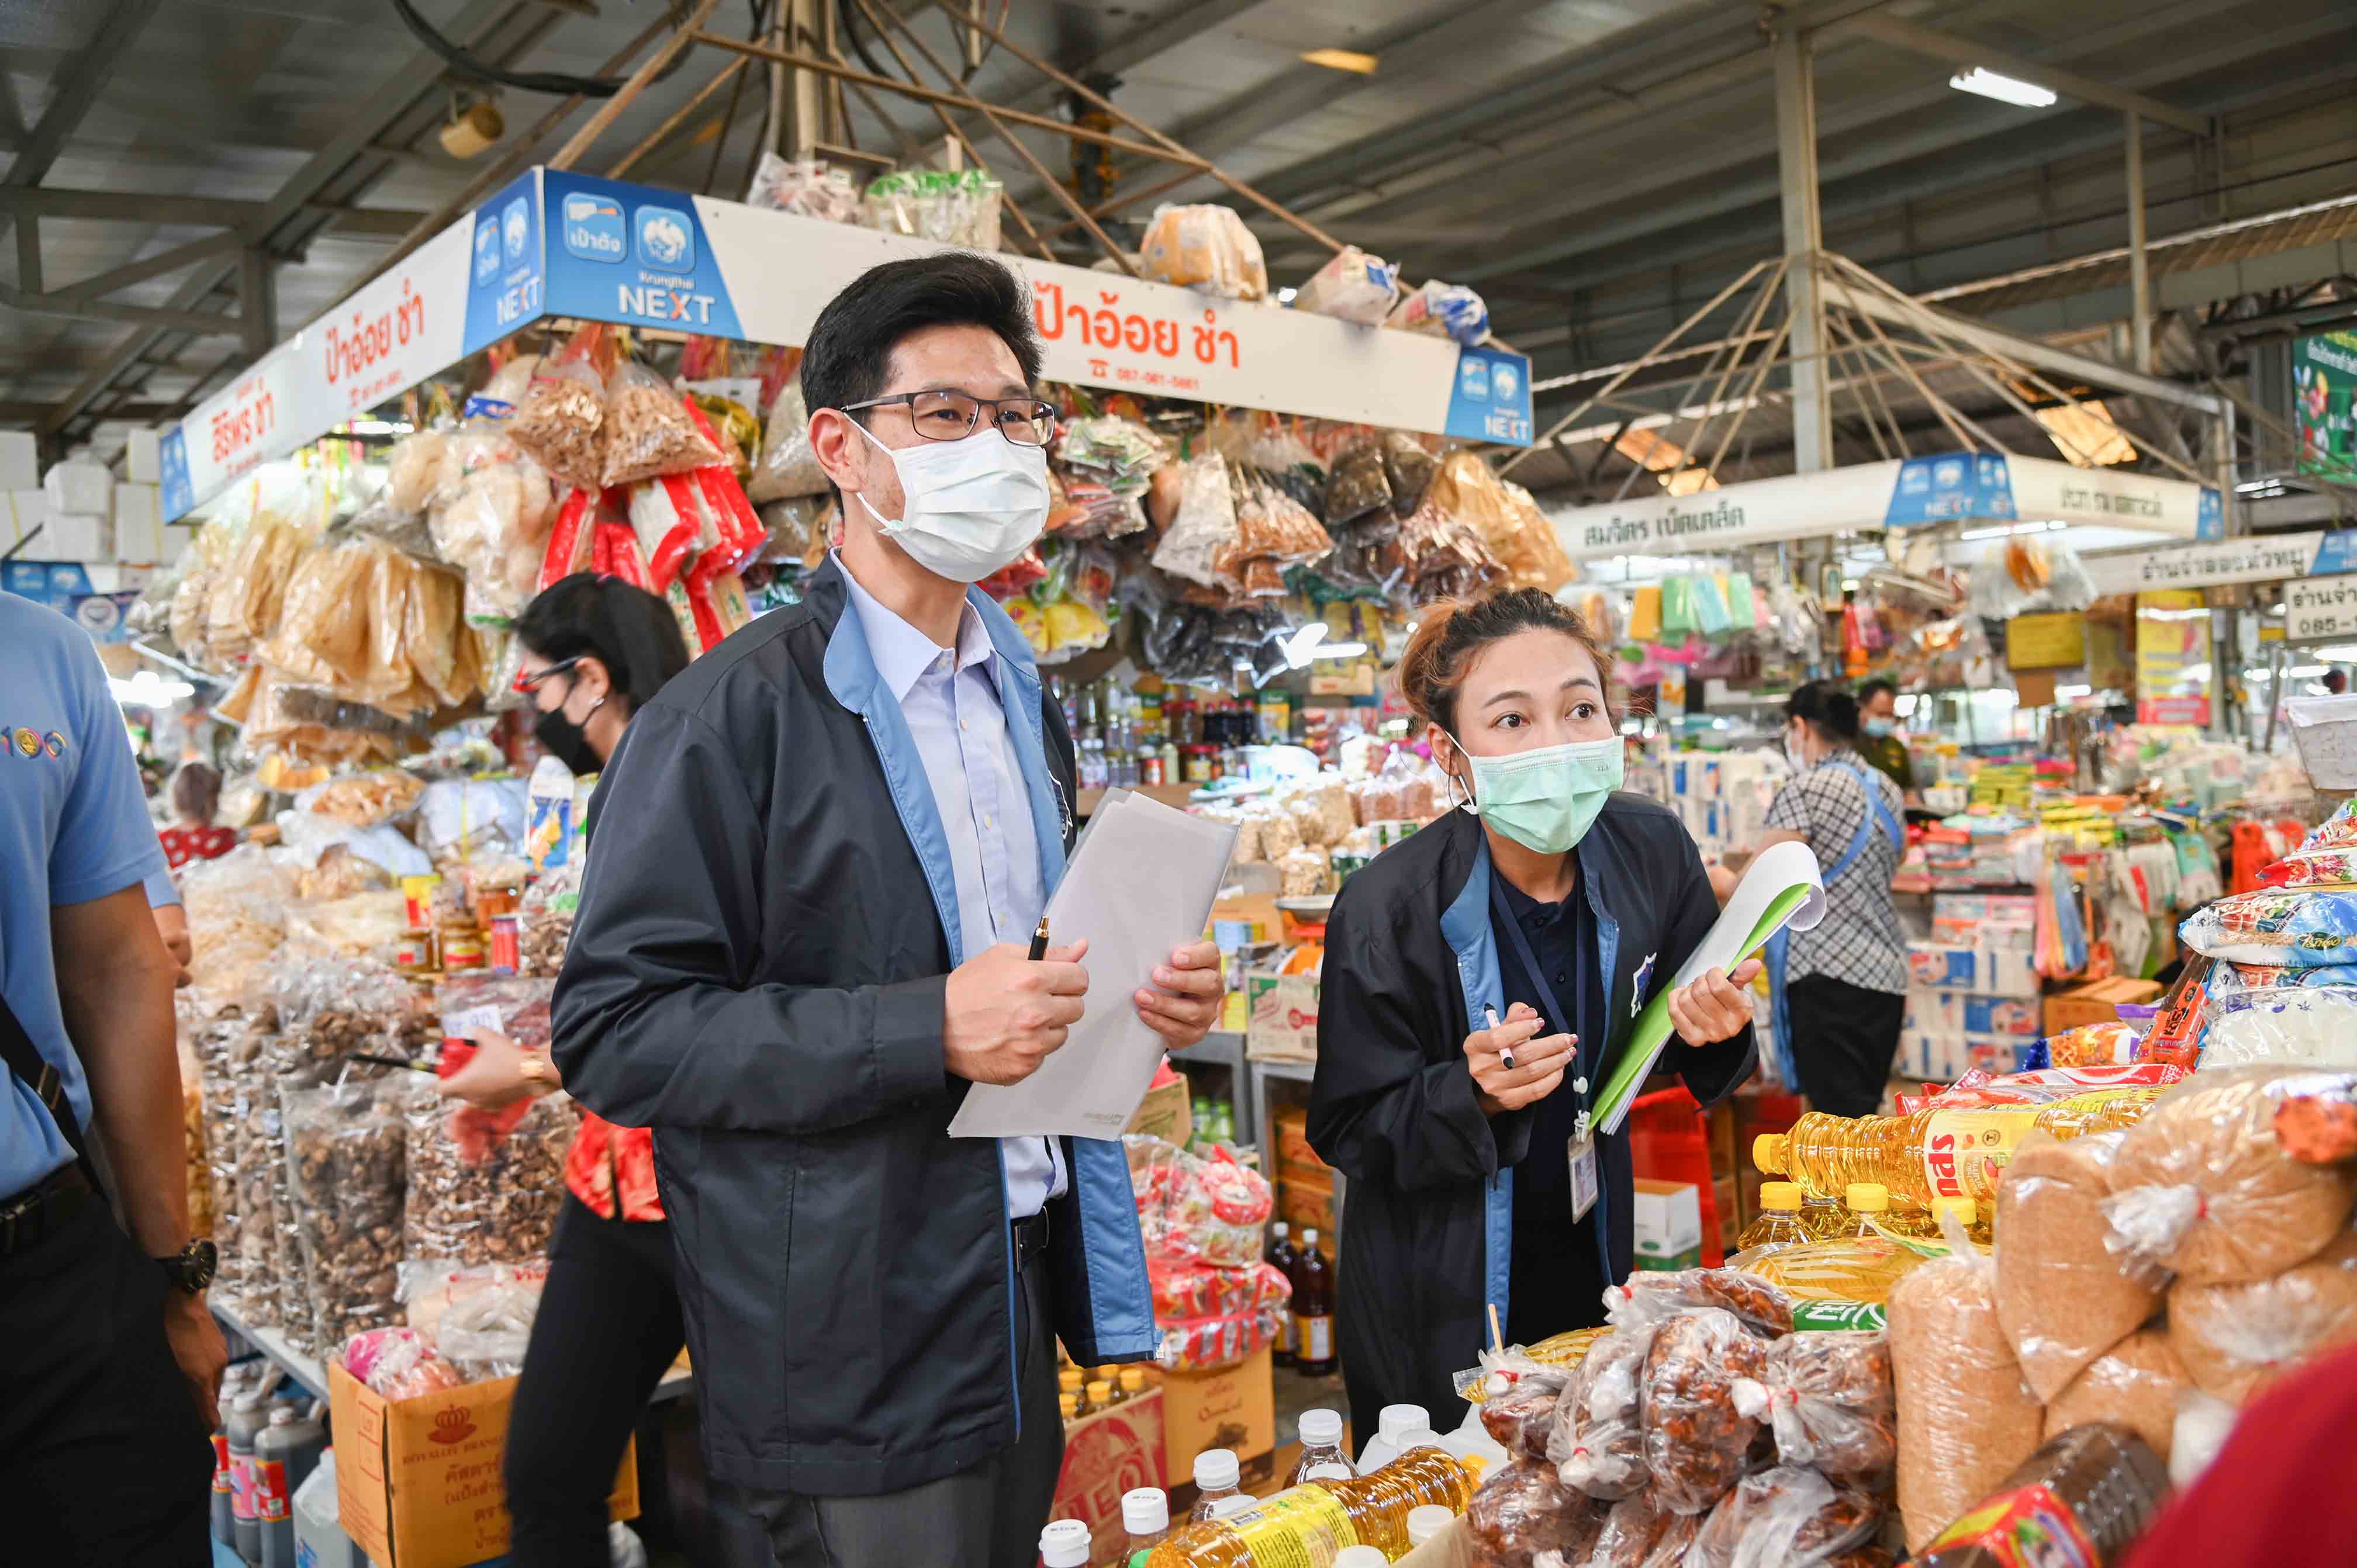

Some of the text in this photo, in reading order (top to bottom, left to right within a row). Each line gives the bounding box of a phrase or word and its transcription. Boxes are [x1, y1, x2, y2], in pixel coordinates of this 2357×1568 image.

[496, 276, 540, 326] NEXT
[618, 283, 716, 325] NEXT
[1034, 281, 1180, 359] ป้าอ้อย
[326, 311, 391, 385] ป้าอ้อย
[1484, 414, 1529, 440] NEXT
